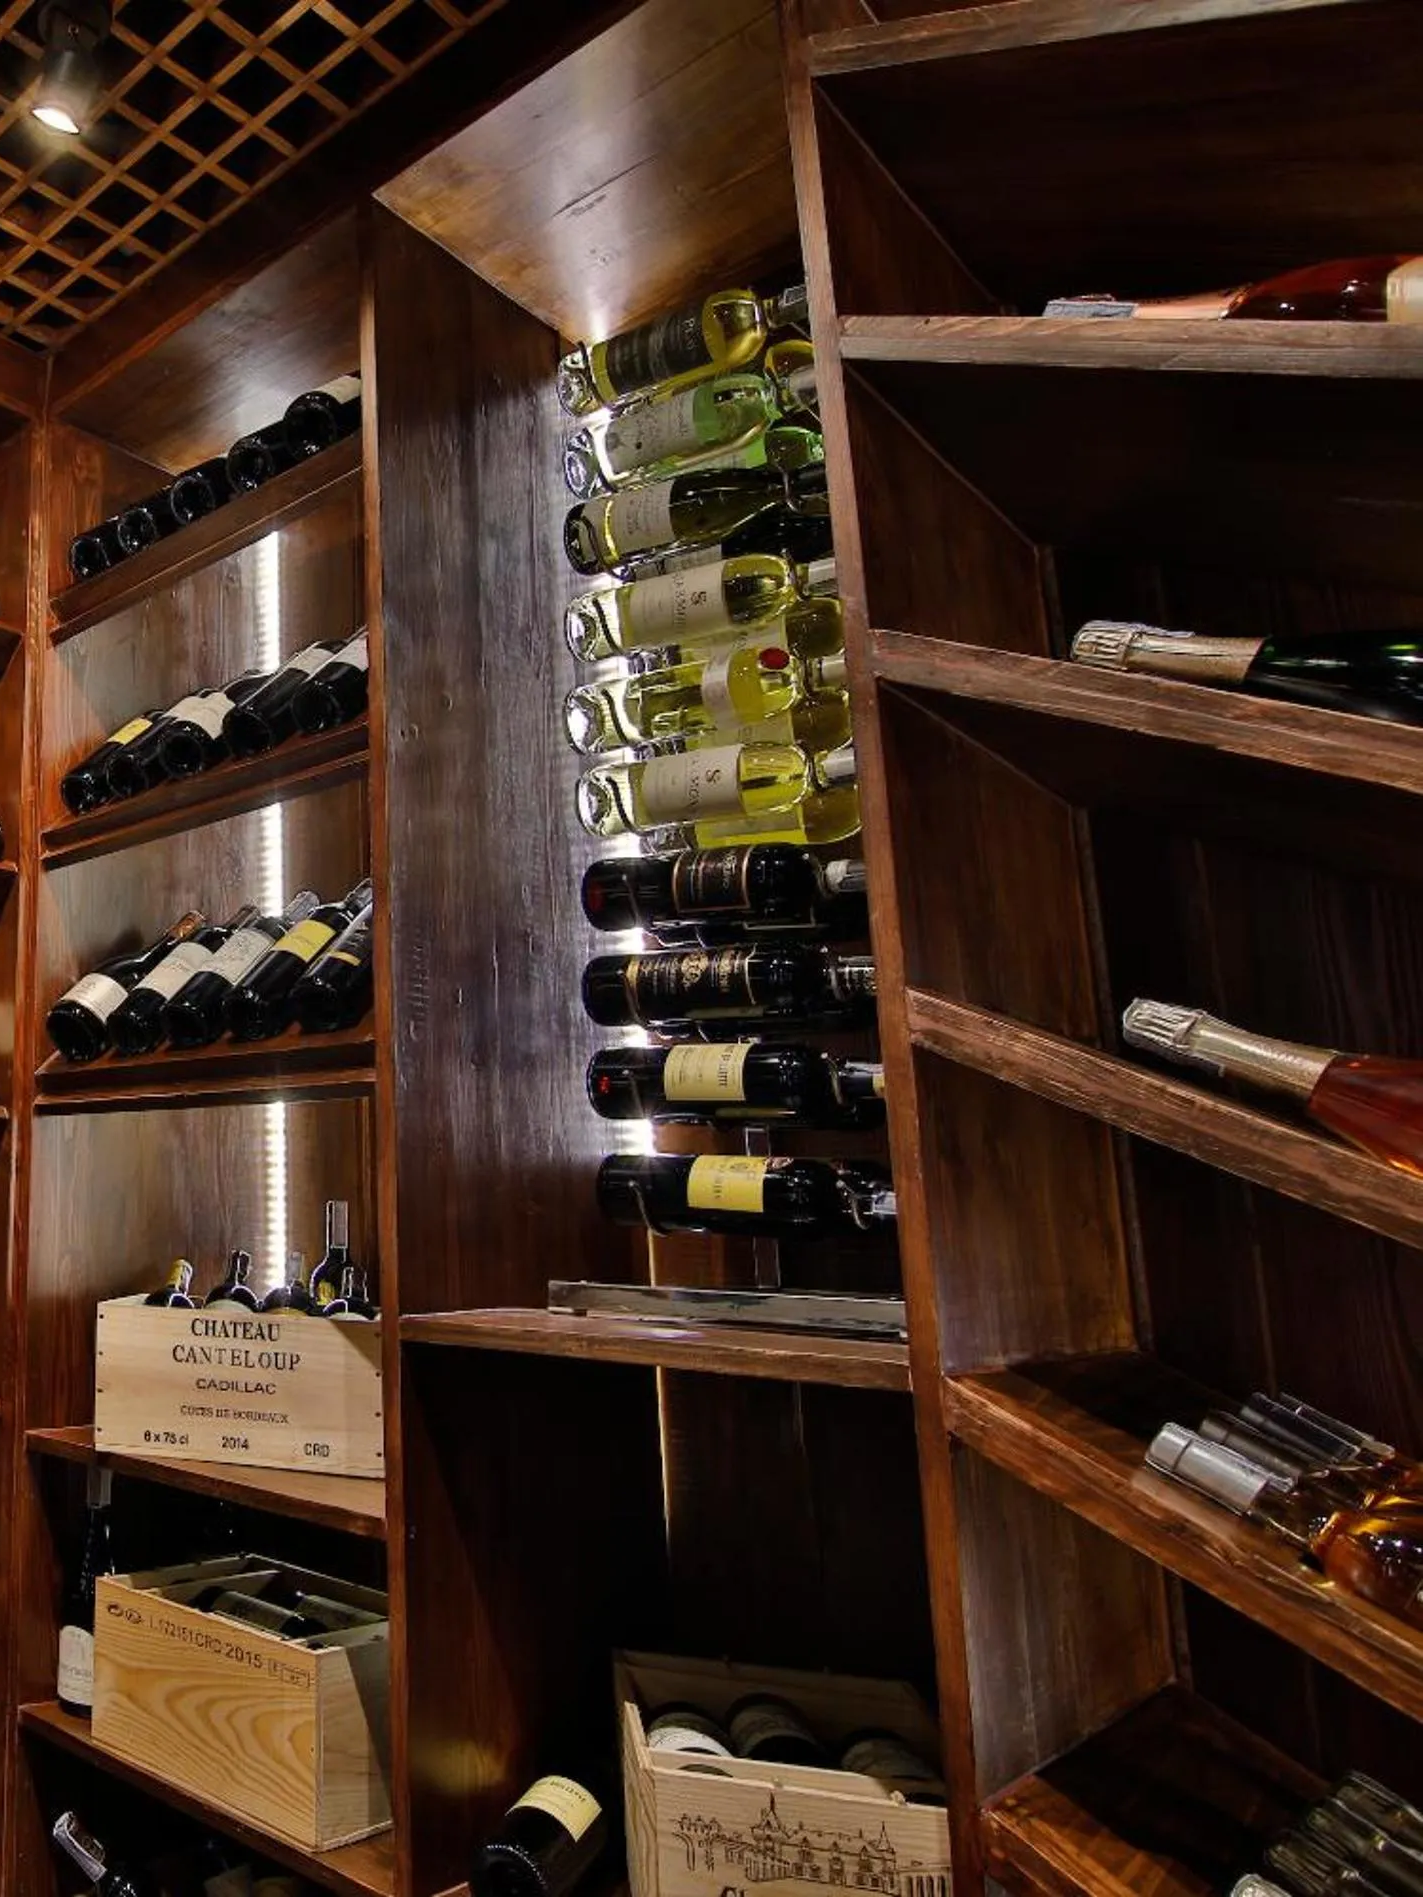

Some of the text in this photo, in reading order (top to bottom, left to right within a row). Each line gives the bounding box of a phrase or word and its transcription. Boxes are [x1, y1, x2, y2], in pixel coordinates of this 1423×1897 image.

[190, 1317, 280, 1342] CHATEAU
[172, 1344, 301, 1371] CANTELOUP
[195, 1377, 277, 1395] CADILLAC
[221, 1435, 250, 1450] 2014
[225, 1643, 264, 1668] 2015
